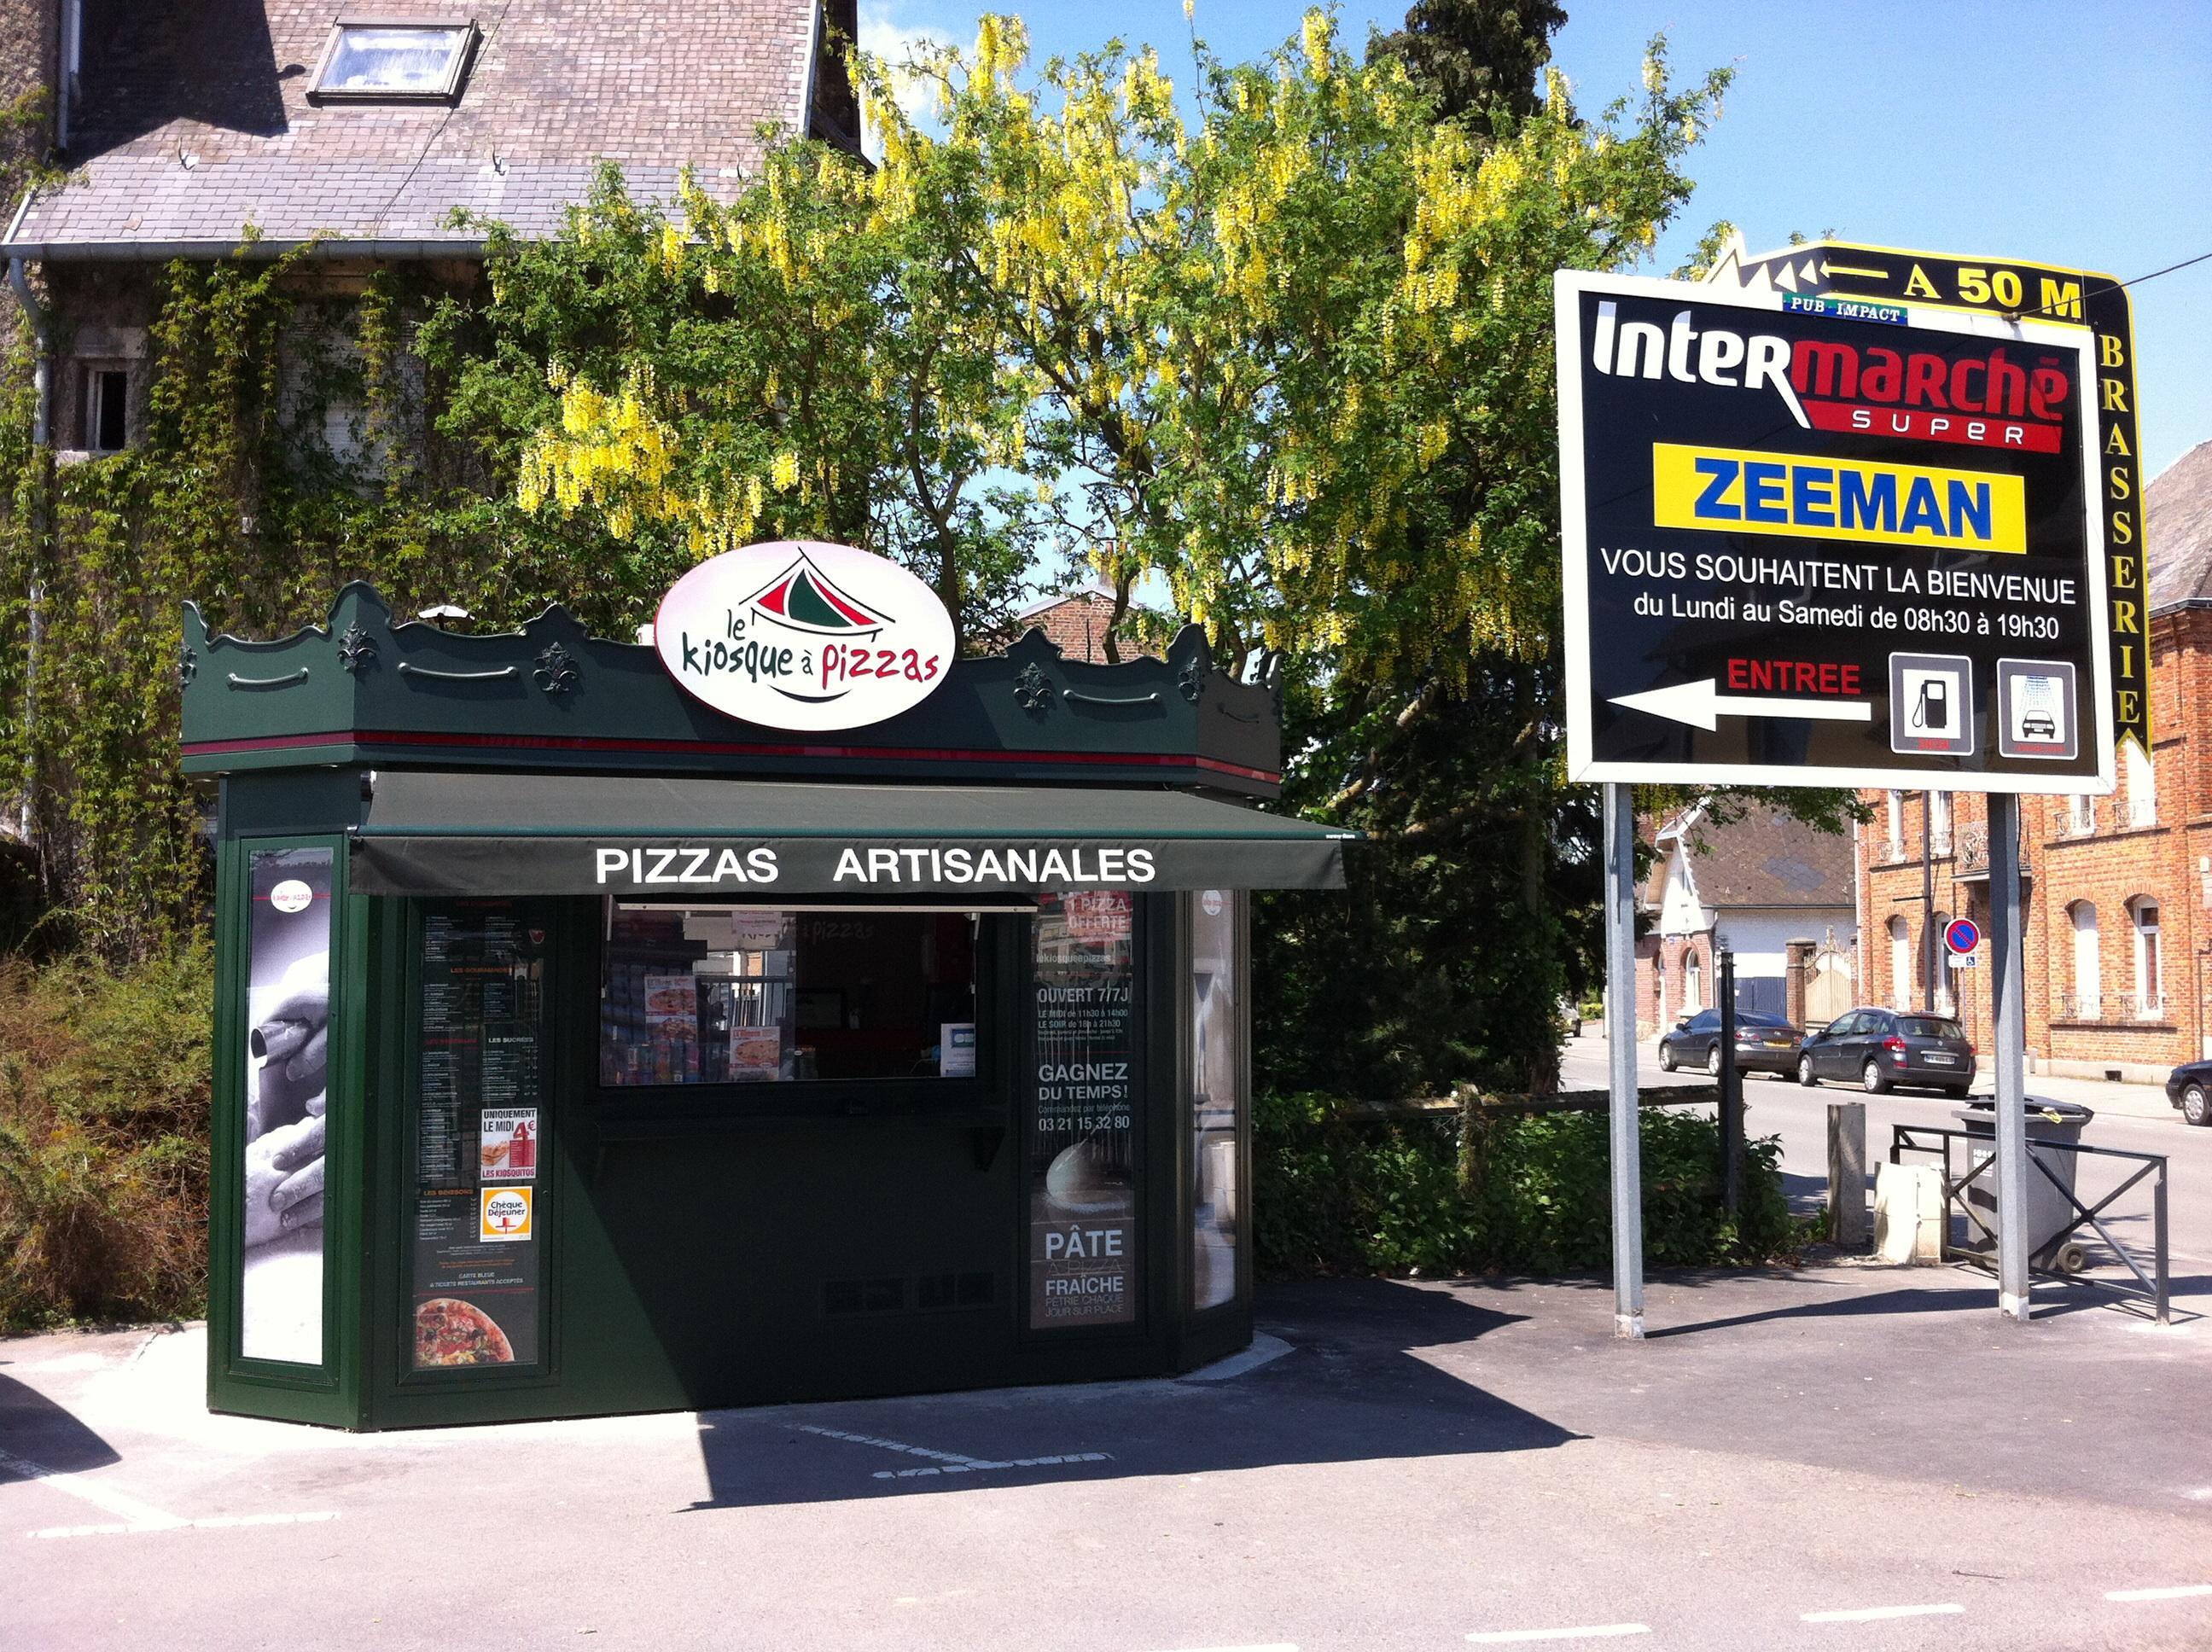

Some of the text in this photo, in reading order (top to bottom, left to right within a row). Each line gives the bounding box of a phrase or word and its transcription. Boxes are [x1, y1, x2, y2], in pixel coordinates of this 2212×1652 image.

[1904, 264, 2082, 318] A 50 M
[1790, 297, 1900, 322] PUB IMPACT
[1695, 457, 1992, 540] ZEEMAN
[2099, 334, 2139, 724] BRASSERIE
[1601, 548, 2075, 604] VOUS SOUHAITENT LA BIENVENUE
[727, 609, 746, 640] le
[1634, 593, 2059, 639] du Lundi au Samedi de 08h30 à 19h30
[683, 631, 939, 690] kiosque à pizzas
[1728, 659, 1861, 695] ENTREE
[596, 848, 1155, 884] PIZZAS ARTISANALES
[1082, 898, 1127, 911] PIZZA
[1069, 916, 1126, 928] OFFERTE
[1038, 987, 1128, 1003] OUVERT 7/7J
[1038, 1063, 1128, 1082] GAGNEZ
[1039, 1086, 1062, 1100] DU
[484, 1109, 536, 1119] UNIQUEMENT
[1039, 1115, 1130, 1131] 03 21 15 32 80
[484, 1121, 493, 1131] LE
[496, 1120, 514, 1131] MIDI
[496, 1168, 534, 1178] KIOSQUITOS
[487, 1208, 526, 1218] Déjeuner
[491, 1201, 522, 1209] Chèque
[1045, 1224, 1123, 1259] PÂTE
[1045, 1274, 1124, 1295] FRAÎCHE
